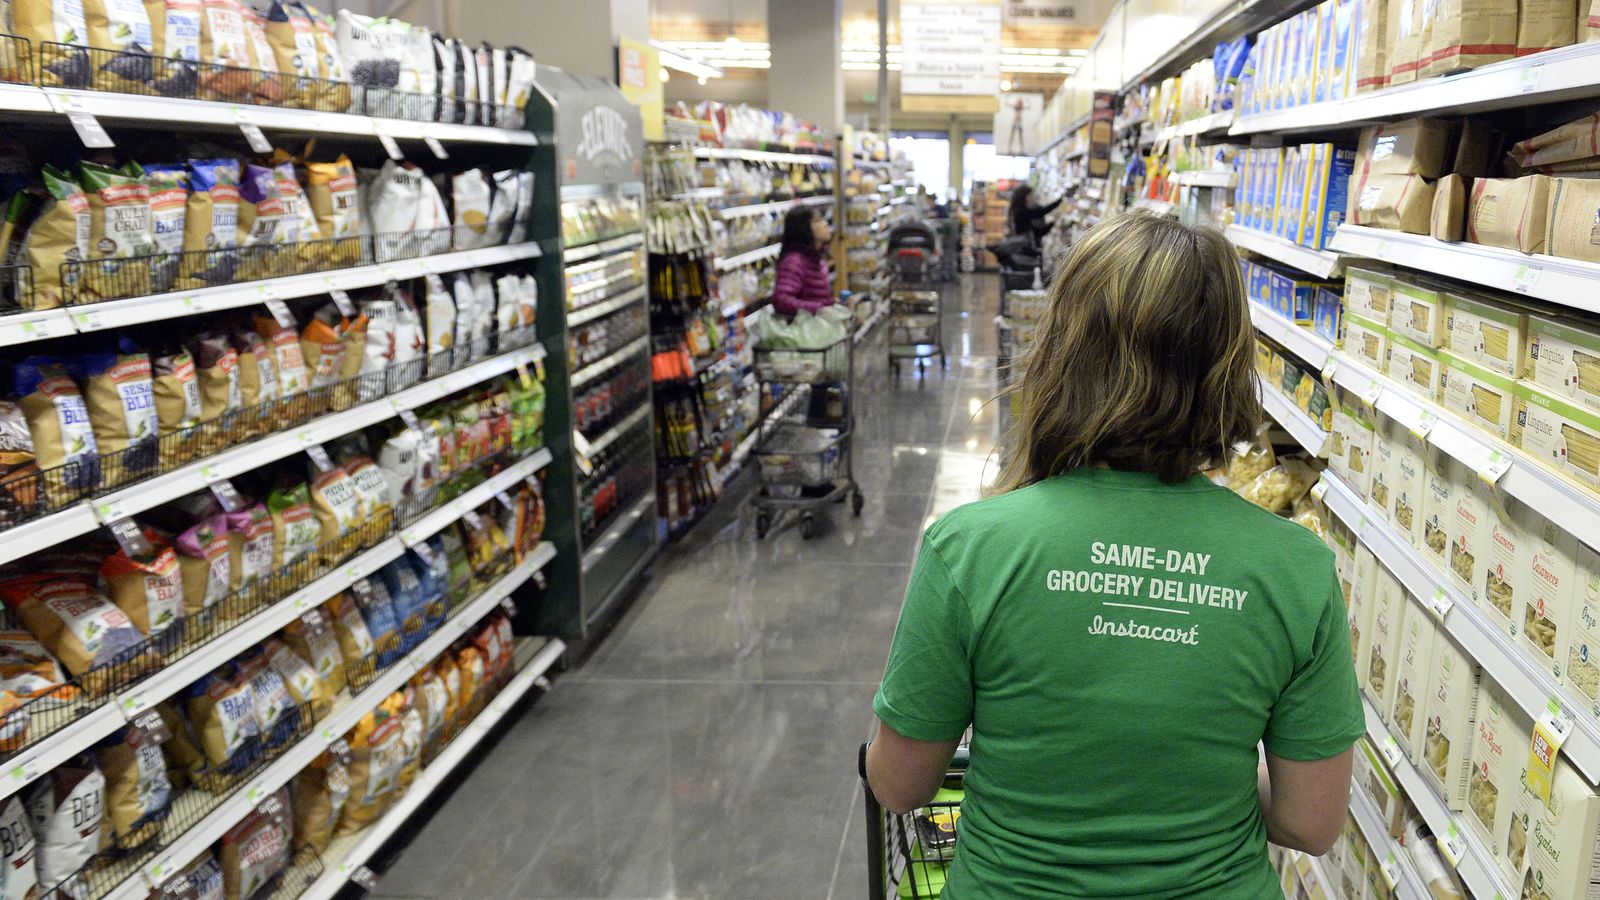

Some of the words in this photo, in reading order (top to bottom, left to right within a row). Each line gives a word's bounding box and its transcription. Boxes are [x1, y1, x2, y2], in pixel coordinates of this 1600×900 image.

[1527, 411, 1553, 437] Linguine
[1090, 541, 1212, 576] SAME-DAY
[1046, 569, 1145, 597] GROCERY
[1149, 578, 1249, 611] DELIVERY
[1087, 614, 1200, 646] Instacart
[1581, 605, 1596, 631] Orzo
[1533, 745, 1550, 766] PRICE
[1535, 733, 1549, 752] LOW
[1534, 819, 1561, 863] Rigatoni
